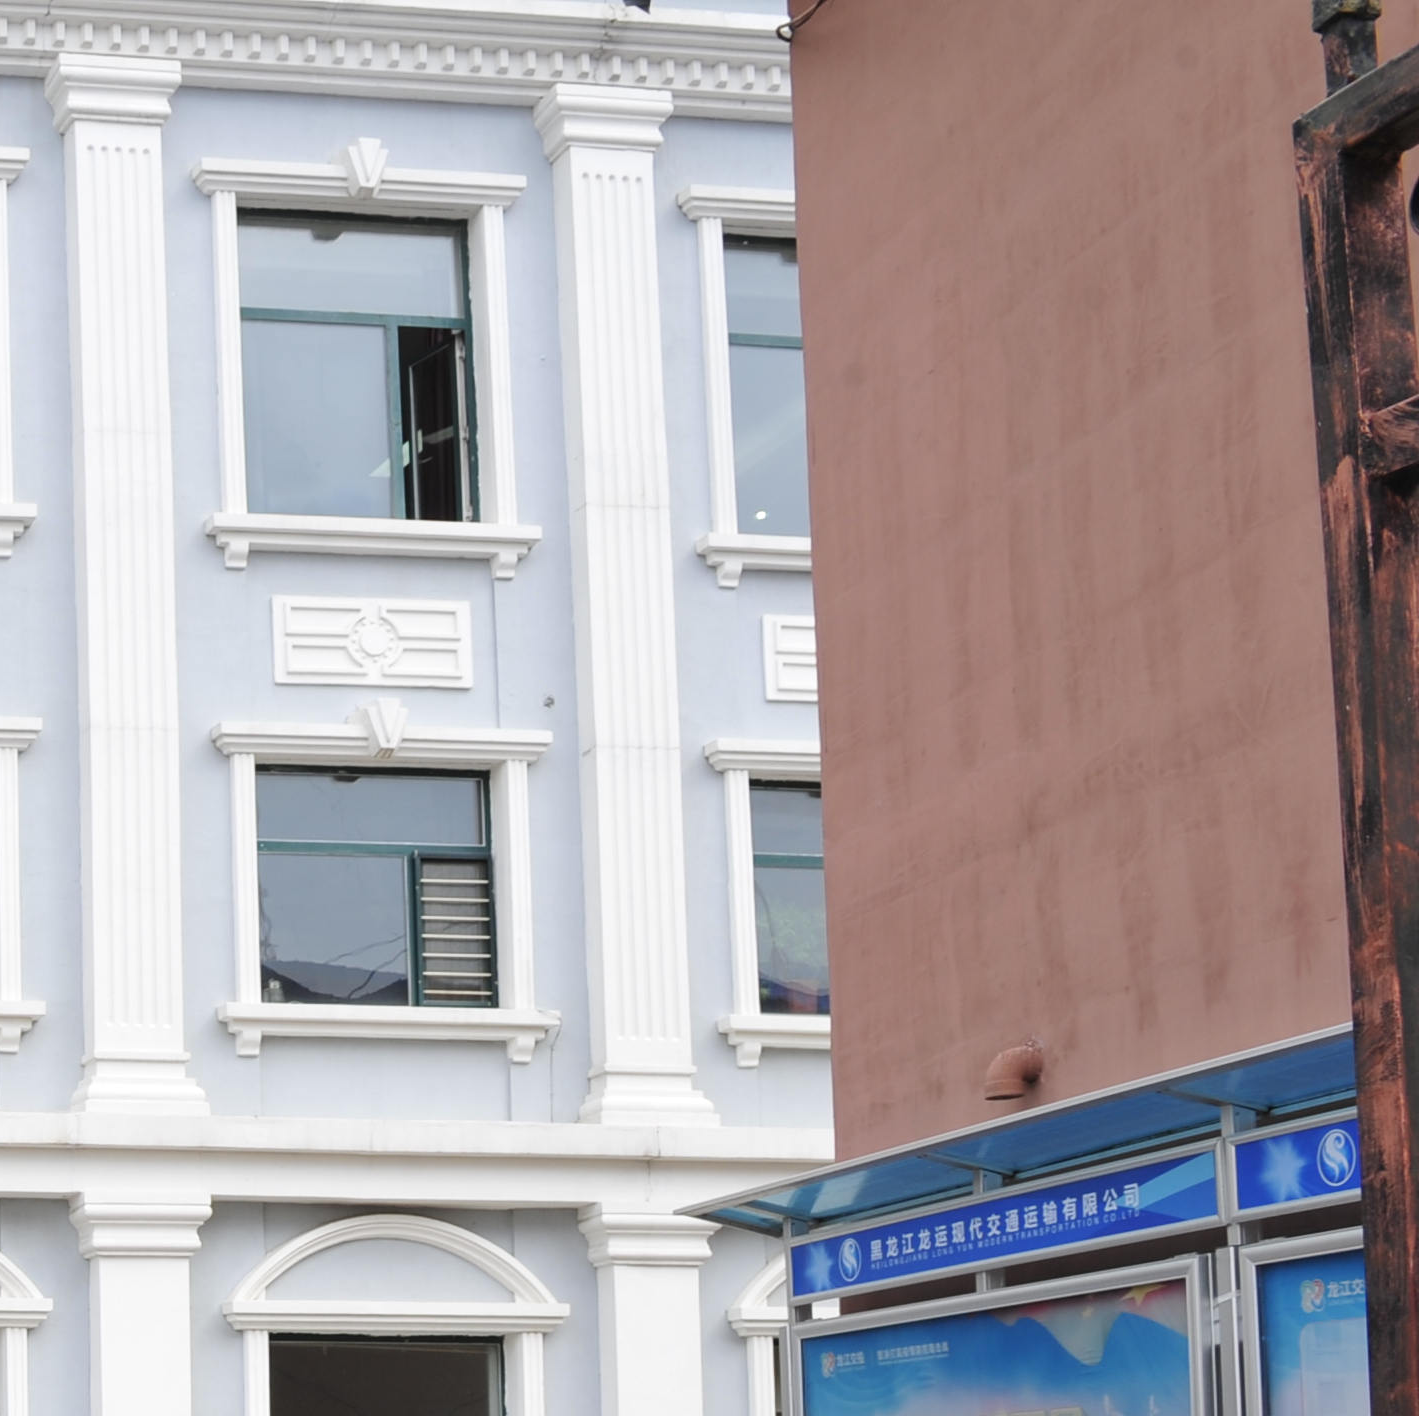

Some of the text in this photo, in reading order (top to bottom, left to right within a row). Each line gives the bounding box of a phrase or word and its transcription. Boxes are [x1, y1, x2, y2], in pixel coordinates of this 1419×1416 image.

[870, 1182, 1142, 1262] 黑龙江龙运现代交通运输有限公司
[870, 1251, 929, 1270] HEILONGJIANG
[932, 1246, 954, 1259] LONG
[956, 1242, 974, 1253] YUN
[976, 1234, 1013, 1249] MODERN
[1015, 1217, 1100, 1241] TRANSPORTATION
